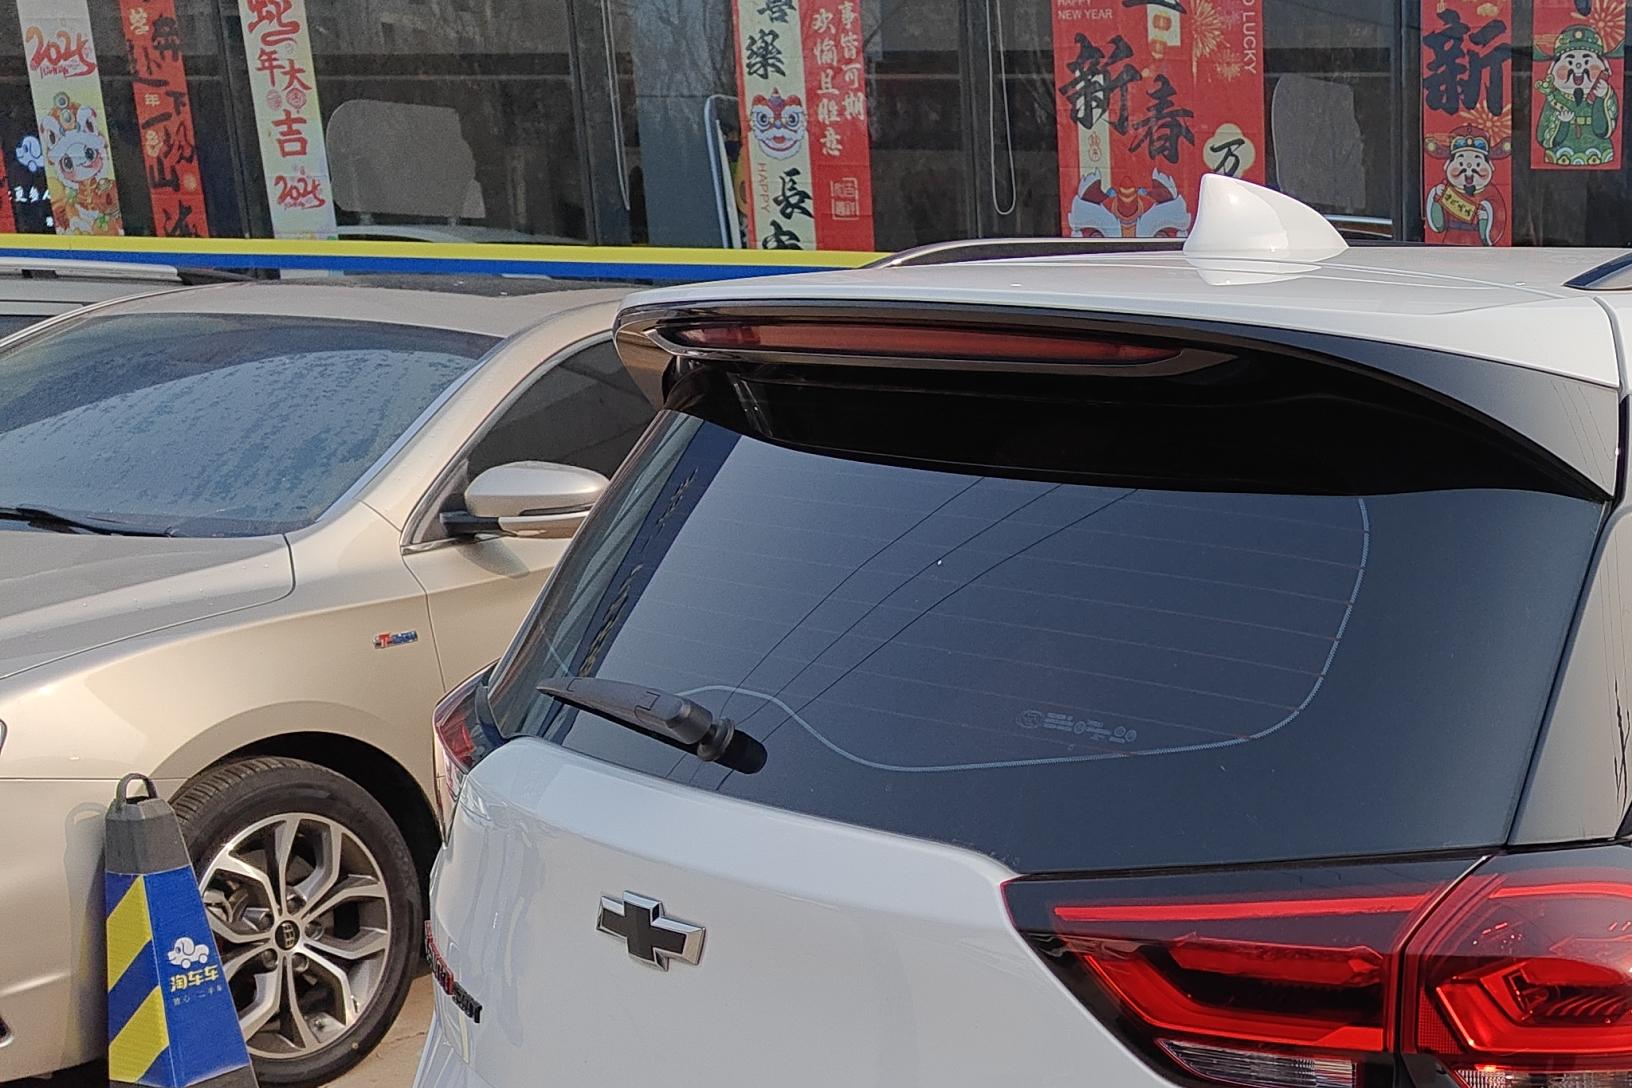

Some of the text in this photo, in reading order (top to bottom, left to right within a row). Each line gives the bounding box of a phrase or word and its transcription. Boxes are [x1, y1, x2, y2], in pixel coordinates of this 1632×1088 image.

[1058, 9, 1113, 20] NEW YEAR
[1242, 12, 1257, 74] LUCKY
[757, 162, 773, 213] HAPPY
[169, 964, 220, 993] 淘车车
